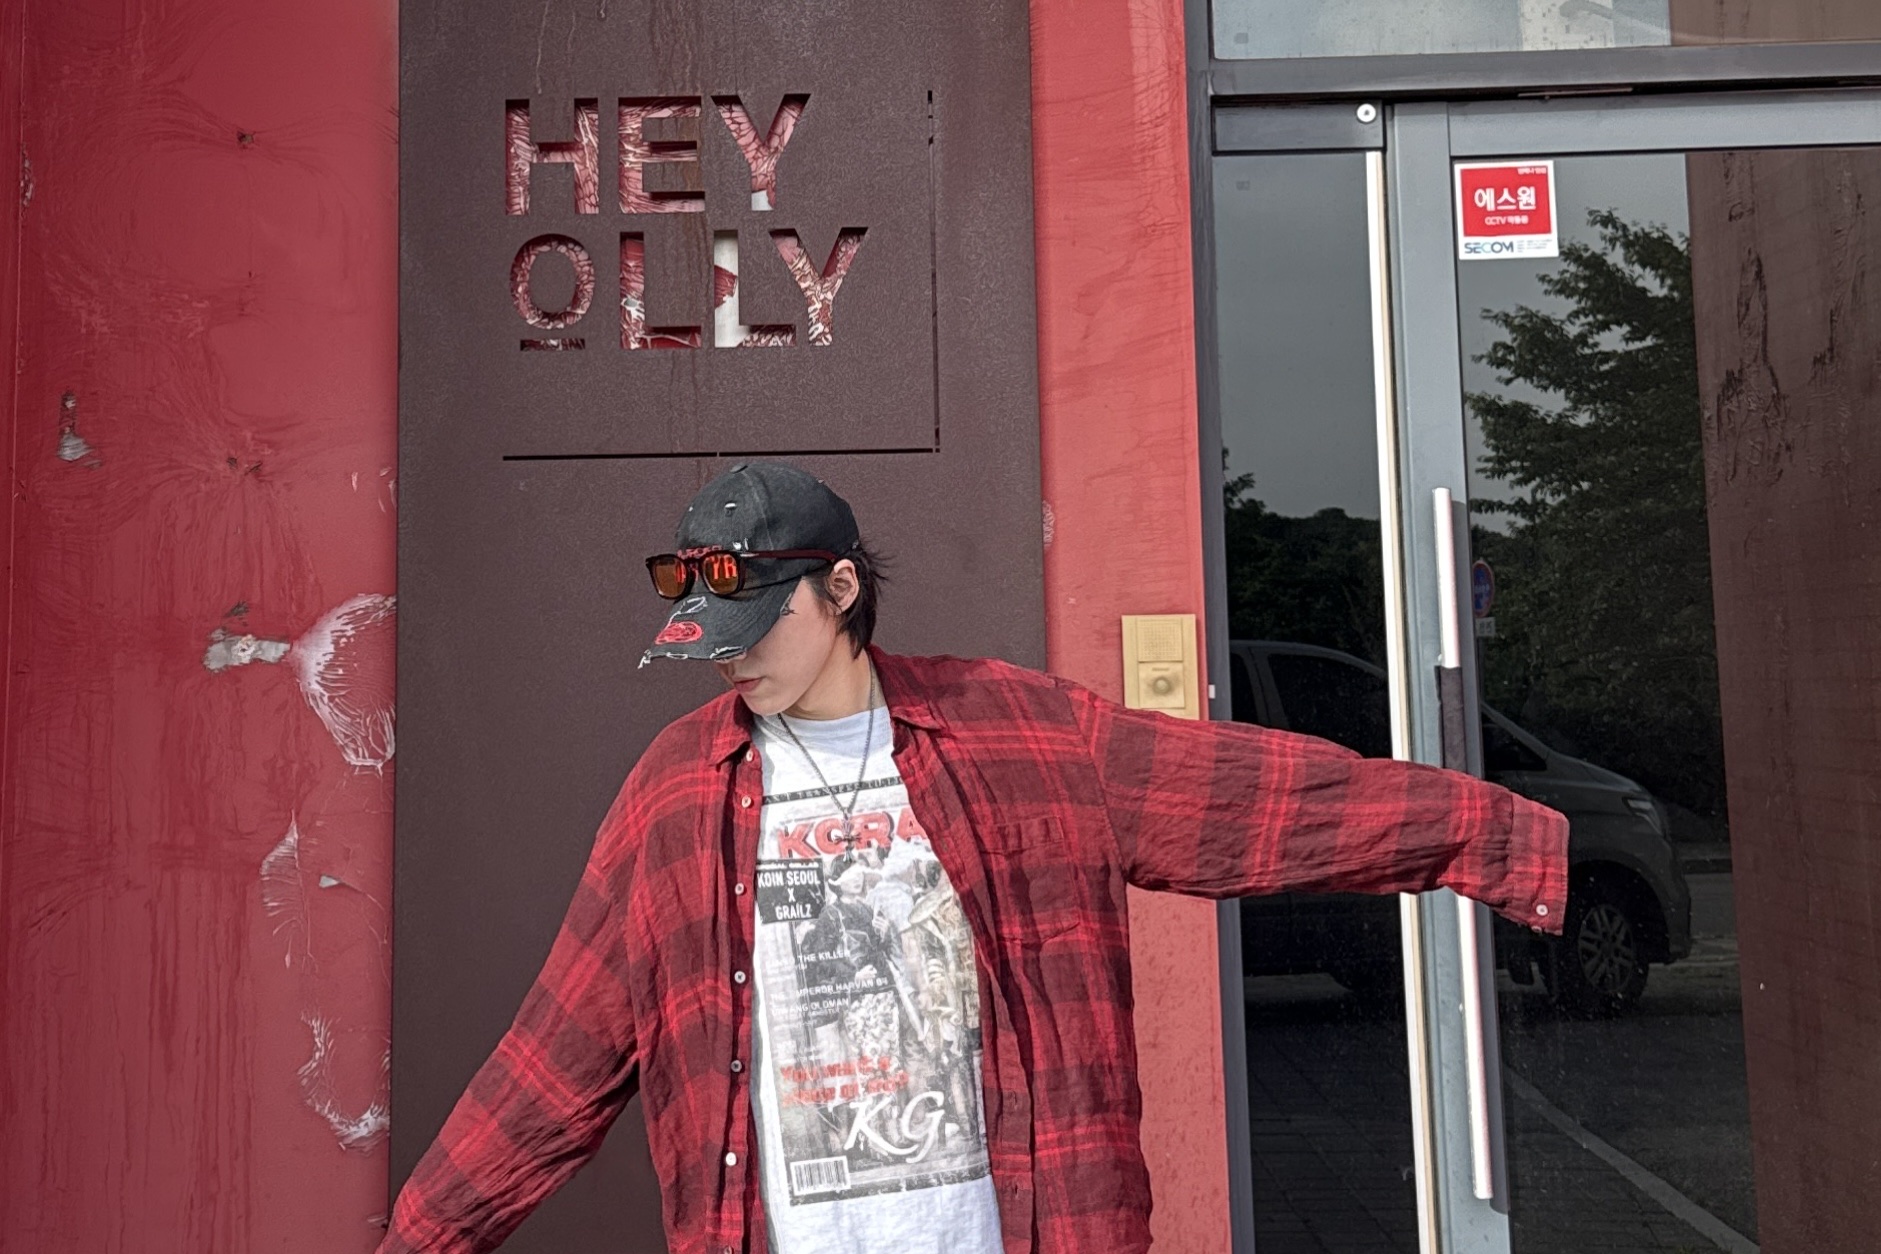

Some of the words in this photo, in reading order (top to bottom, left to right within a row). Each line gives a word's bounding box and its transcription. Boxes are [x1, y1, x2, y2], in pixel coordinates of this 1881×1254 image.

[504, 93, 811, 215] HEY
[1474, 186, 1536, 211] 에스원
[1484, 215, 1506, 226] CCTV
[1464, 241, 1514, 254] SECOM
[509, 227, 868, 350] OLLY
[757, 871, 784, 888] KOIN
[786, 870, 821, 886] SEOUL
[787, 887, 796, 902] X
[775, 902, 812, 920] GRAILZ
